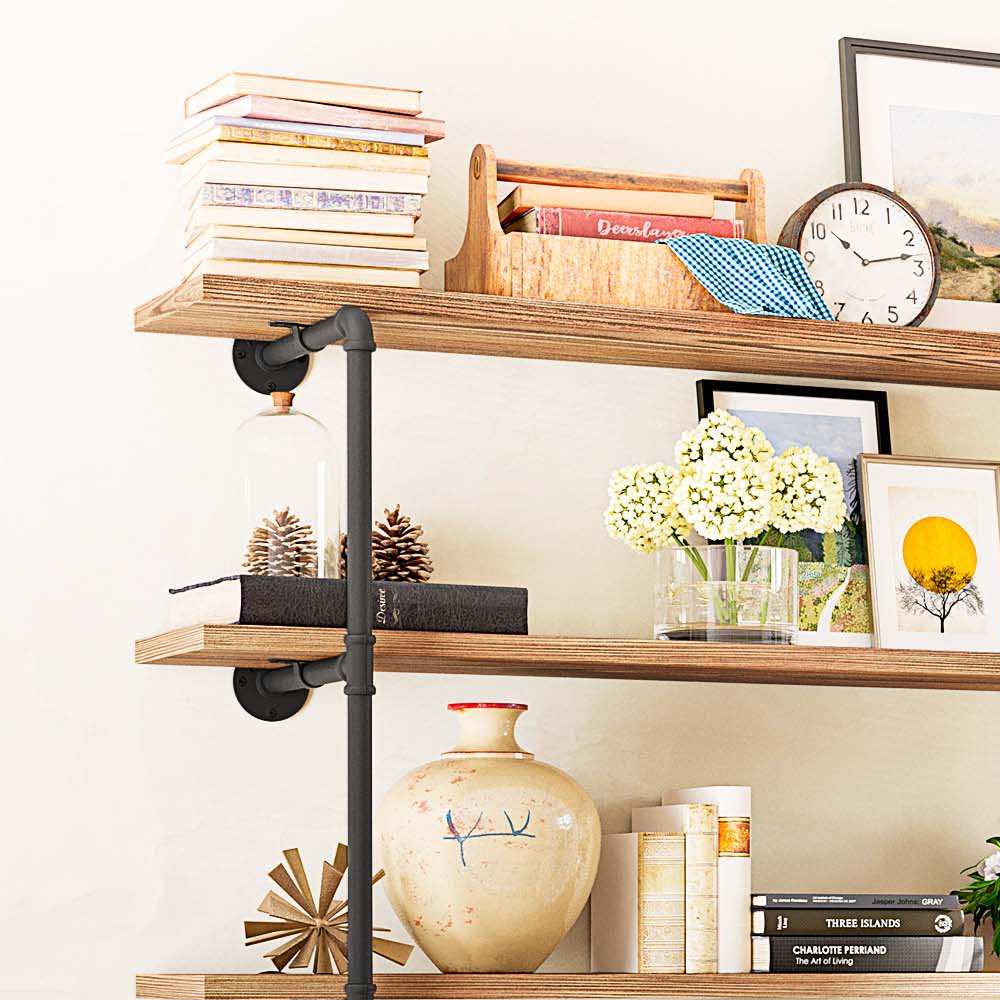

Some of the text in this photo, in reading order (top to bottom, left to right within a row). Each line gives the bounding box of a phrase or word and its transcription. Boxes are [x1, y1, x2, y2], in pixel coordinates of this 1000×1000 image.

[832, 203, 843, 221] 11
[853, 197, 870, 216] 12
[886, 208, 891, 225] 1
[810, 222, 827, 241] 10
[903, 229, 915, 247] 2
[803, 251, 816, 268] 9
[913, 260, 925, 277] 3
[814, 280, 825, 297] 8
[905, 290, 918, 305] 4
[834, 302, 847, 322] 7
[861, 311, 874, 325] 6
[887, 306, 899, 324] 5
[872, 898, 895, 906] Jasper
[921, 898, 944, 906] GRAY
[825, 918, 901, 928] THREE ISLANDS
[792, 945, 887, 955] CHARLOTTE PERRIAND
[795, 957, 854, 967] The Art of Living
